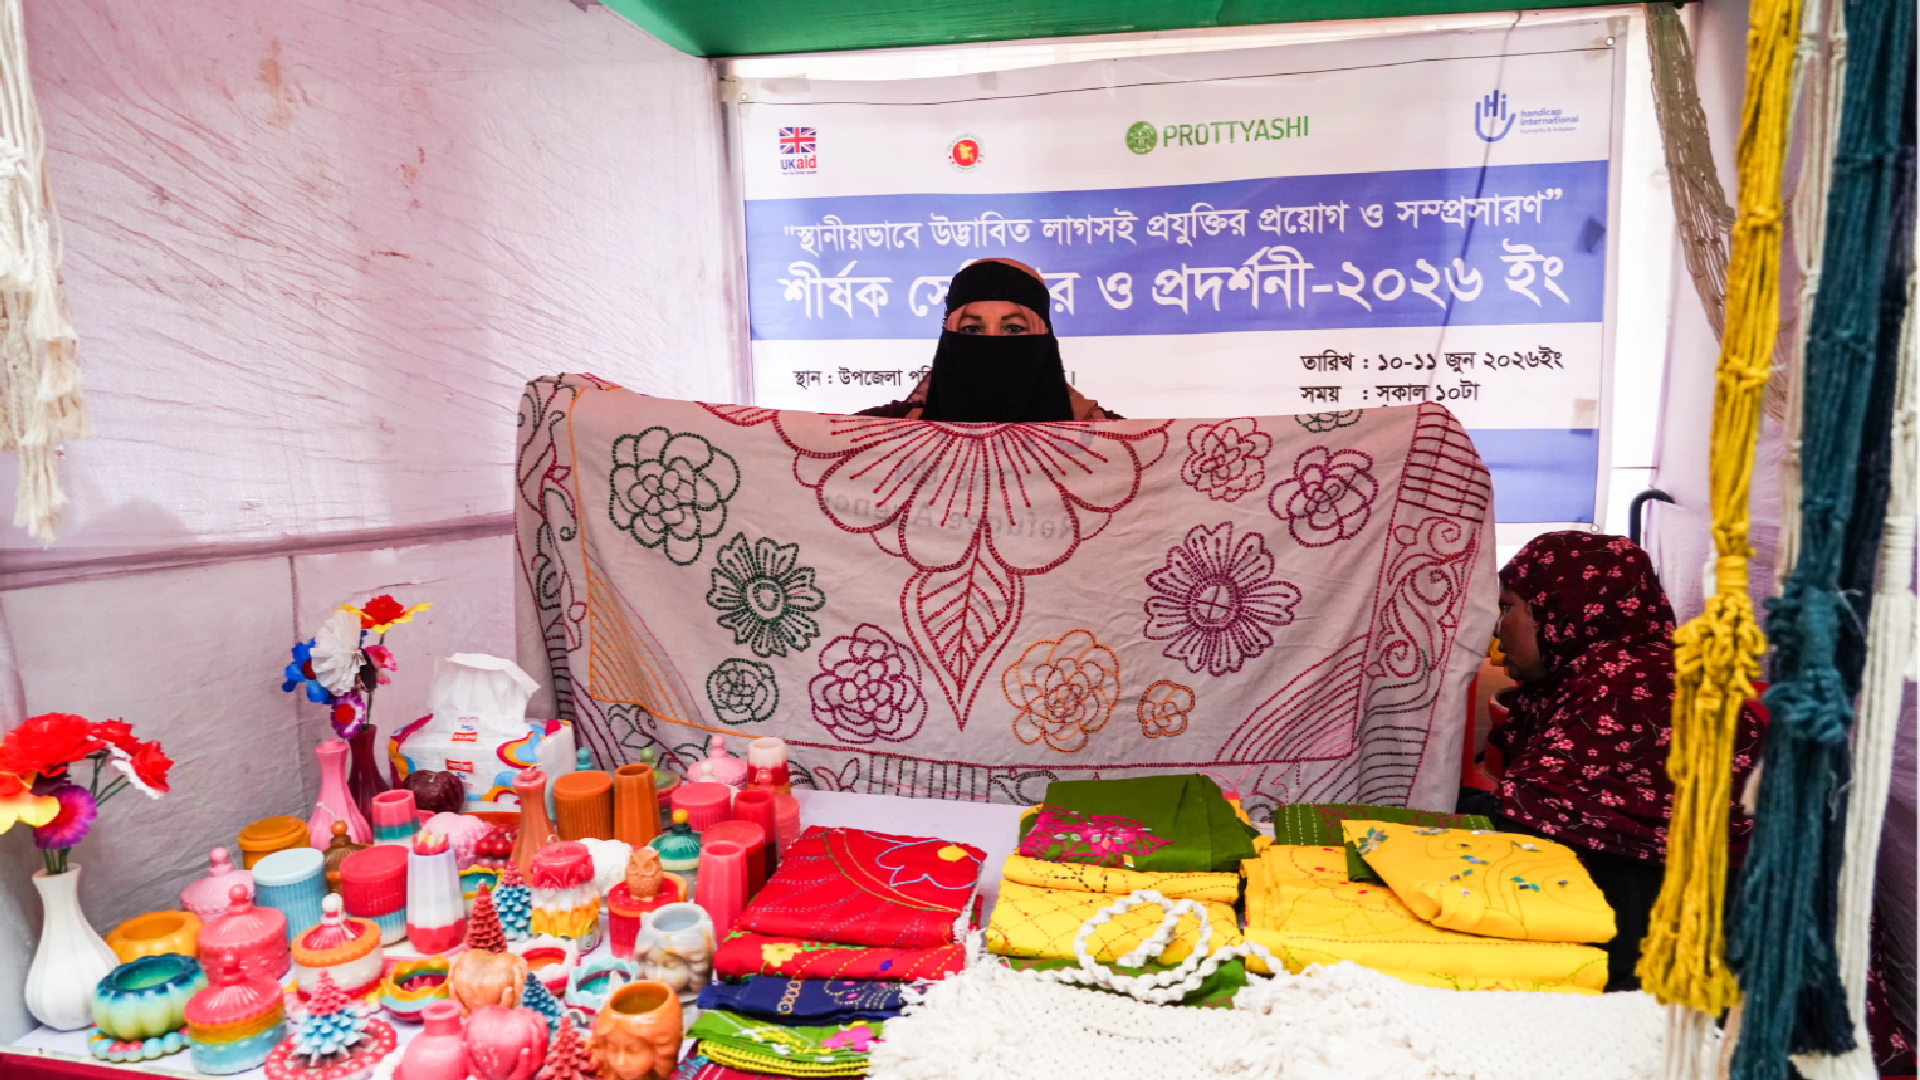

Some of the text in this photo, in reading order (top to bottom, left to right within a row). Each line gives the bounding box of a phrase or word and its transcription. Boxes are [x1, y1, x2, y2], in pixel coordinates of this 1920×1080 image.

[1520, 108, 1563, 117] handicap
[1520, 115, 1579, 126] international
[1163, 115, 1309, 147] PROTTYASHI
[928, 210, 1035, 248] উদ্ভাবিত
[1040, 208, 1139, 245] লাগসই
[1146, 203, 1250, 247] প্রযুক্তির
[1258, 200, 1350, 234] প্রয়োগ
[1360, 203, 1384, 228] ও
[777, 261, 894, 319] শীর্ষক
[1096, 271, 1134, 310] ও
[1499, 238, 1571, 307] ইং
[1299, 349, 1356, 371] তারিখ
[1377, 354, 1437, 371] ১০-১১
[1444, 351, 1477, 374] জুন
[792, 370, 823, 390] স্থান
[837, 366, 904, 386] উপজেলা
[1299, 385, 1342, 404] সময়
[1374, 384, 1430, 402] সকাল
[1435, 379, 1481, 402] ১০টা
